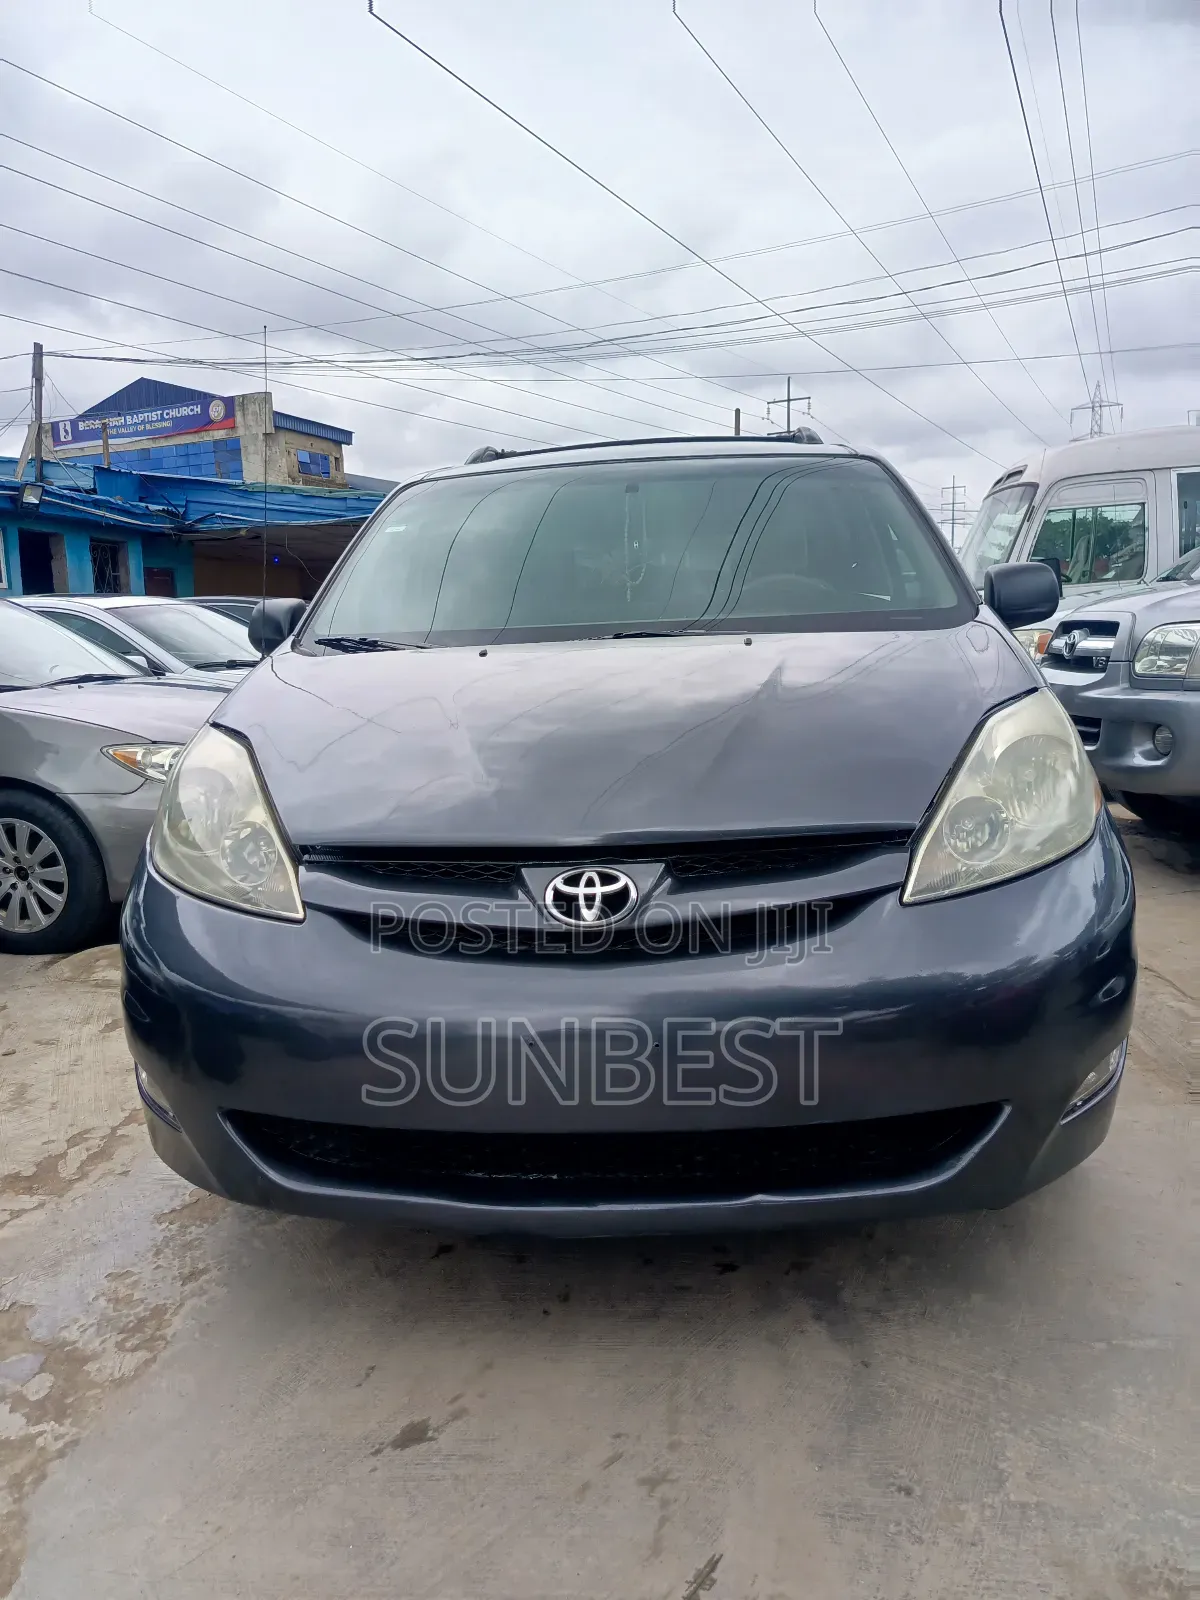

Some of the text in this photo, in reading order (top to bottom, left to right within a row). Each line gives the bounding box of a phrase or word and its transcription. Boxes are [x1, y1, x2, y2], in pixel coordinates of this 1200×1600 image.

[126, 411, 162, 424] BAPTIST
[163, 405, 201, 419] CHURCH
[119, 425, 136, 433] VALLEY
